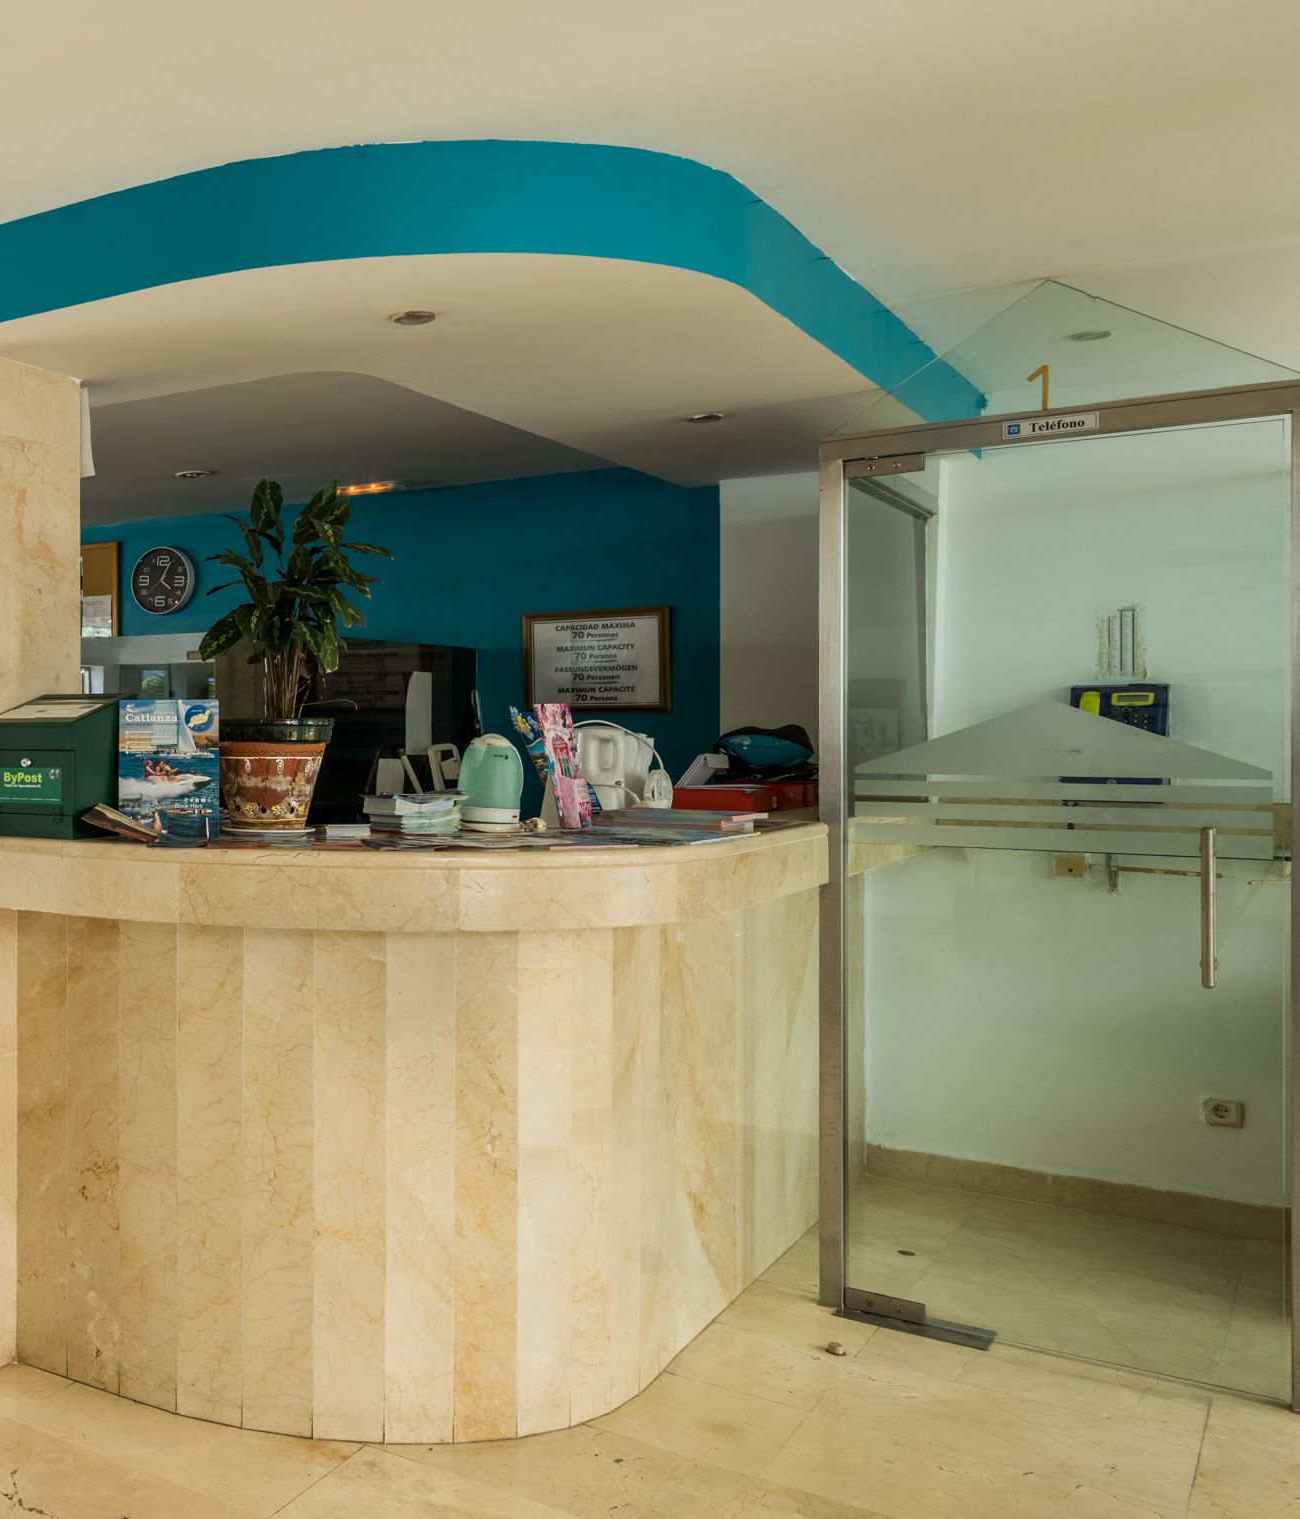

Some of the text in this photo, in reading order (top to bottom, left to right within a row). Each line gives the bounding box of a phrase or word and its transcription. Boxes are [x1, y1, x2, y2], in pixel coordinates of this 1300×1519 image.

[1026, 364, 1049, 410] 1
[1029, 419, 1085, 433] Teléfono
[156, 555, 171, 567] 12
[138, 575, 150, 587] 9
[173, 575, 185, 587] 3
[154, 595, 166, 607] 6
[555, 620, 636, 632] CAPACIDAD MÁXIMA
[571, 631, 584, 639] 70
[556, 643, 635, 653] MAXIMUN CAPACITY
[574, 652, 587, 660] 70
[571, 673, 584, 681] 70
[557, 686, 596, 694] MAXIMUN
[574, 694, 588, 702] 70
[125, 713, 178, 723] Catlanza
[3, 771, 43, 785] ByPost
